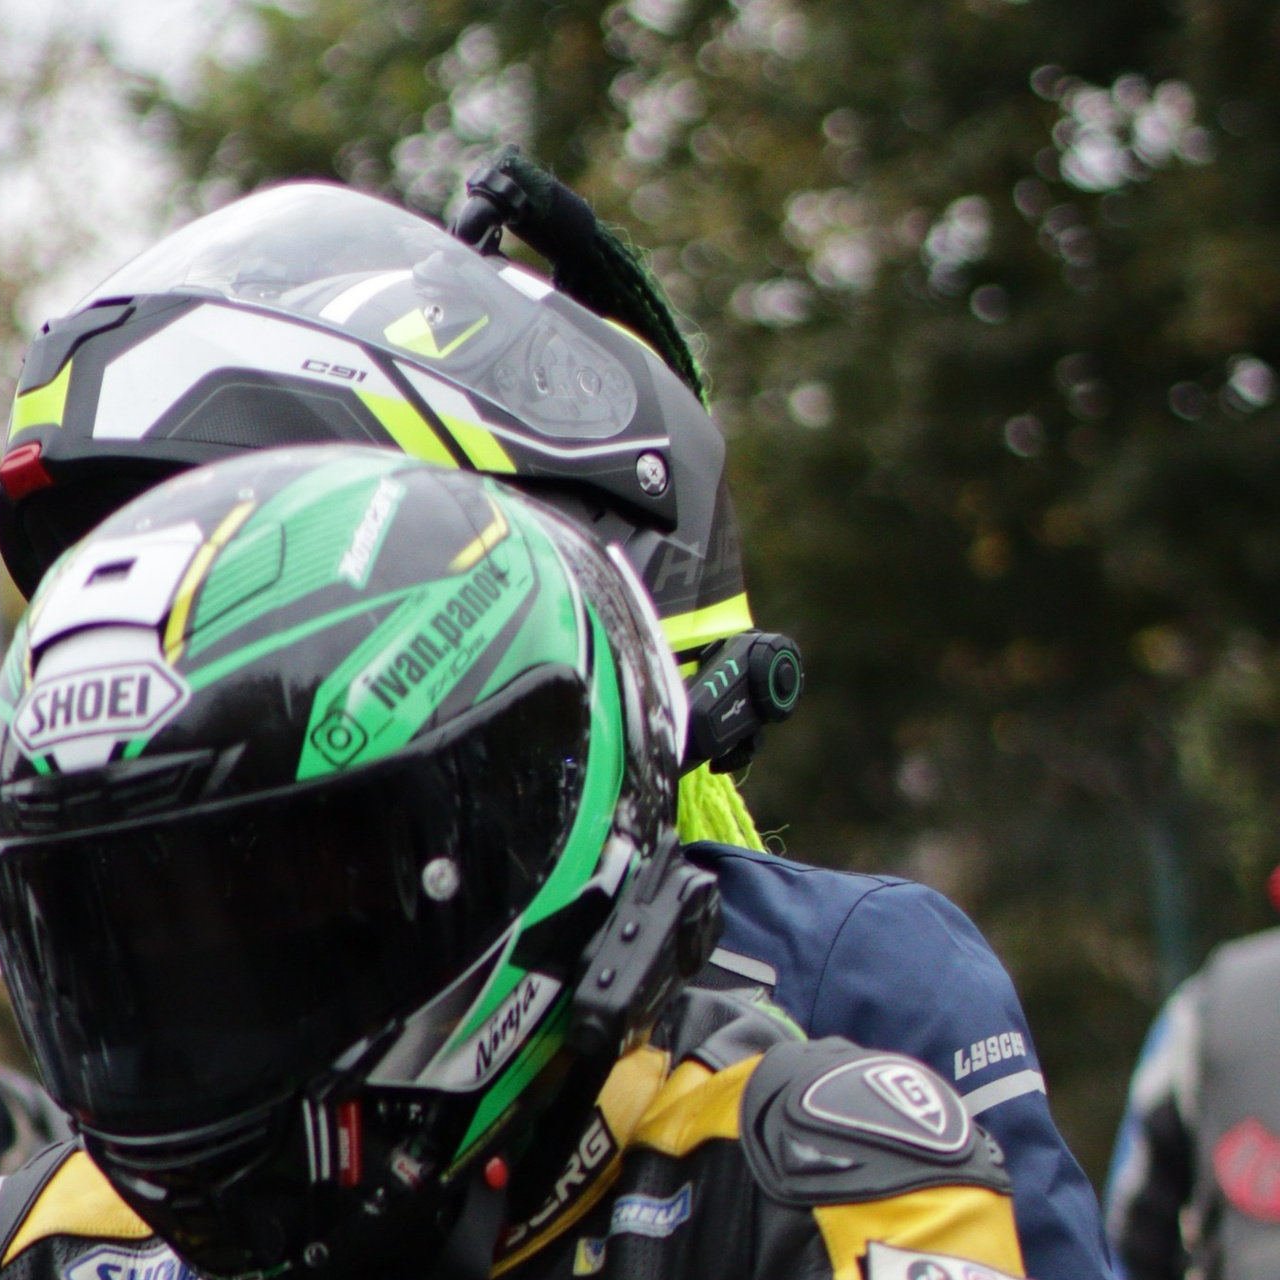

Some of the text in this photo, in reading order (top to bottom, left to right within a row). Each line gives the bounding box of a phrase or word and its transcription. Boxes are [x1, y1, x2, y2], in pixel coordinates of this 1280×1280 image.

[300, 359, 368, 384] C91
[29, 674, 151, 737] SHOEI
[475, 981, 540, 1079] Ninja
